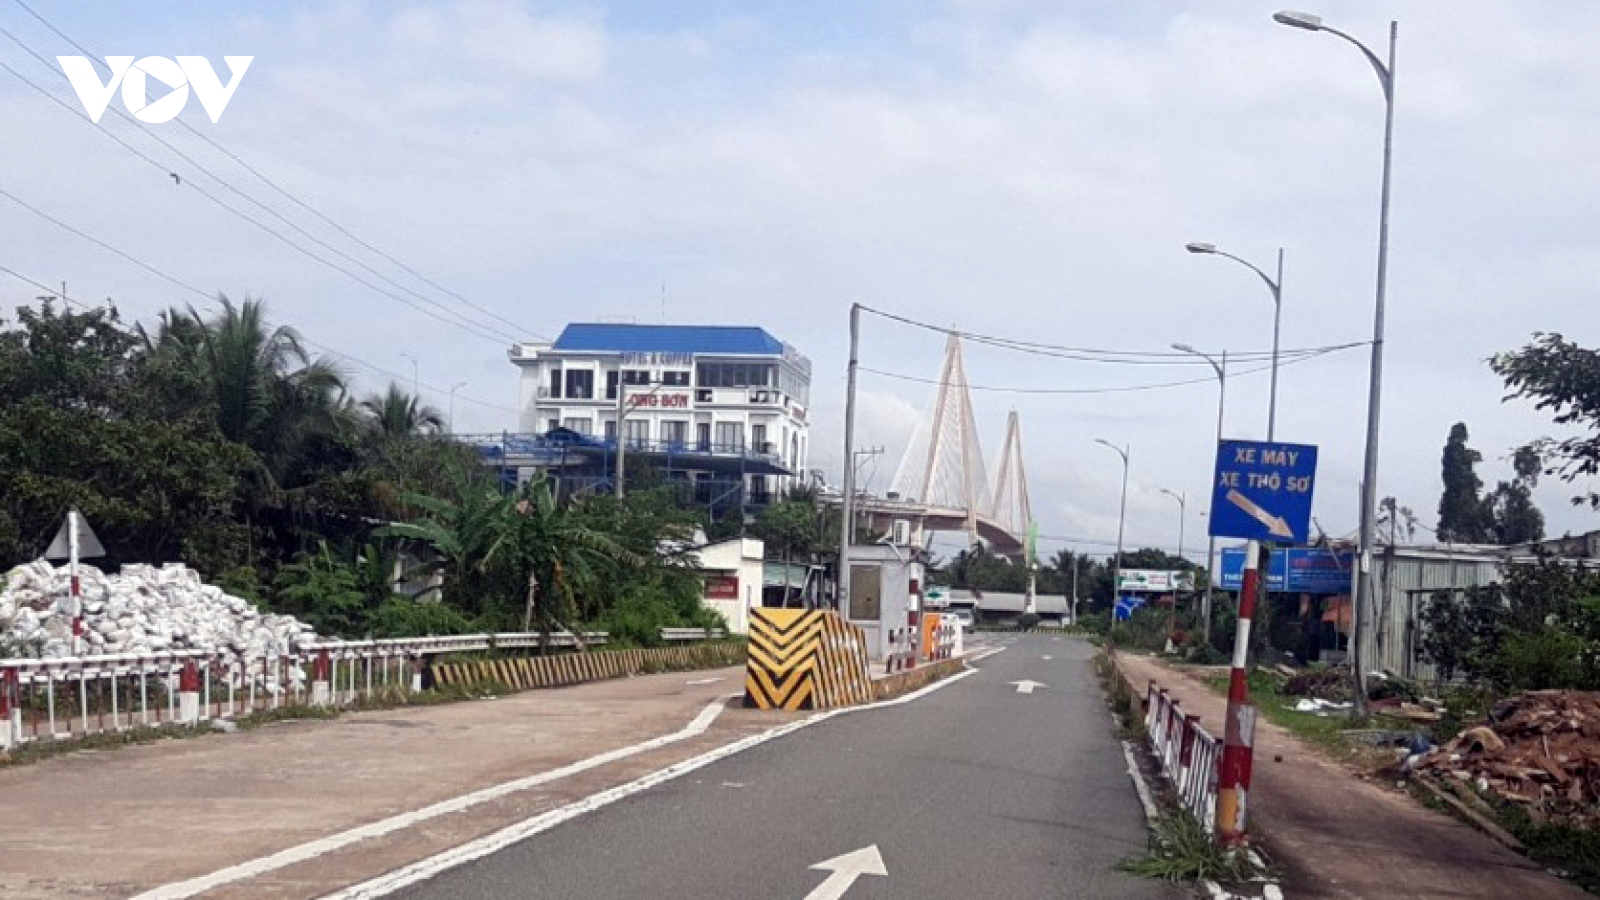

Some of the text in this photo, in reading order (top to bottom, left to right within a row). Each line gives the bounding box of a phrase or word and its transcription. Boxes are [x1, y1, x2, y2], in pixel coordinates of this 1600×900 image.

[1234, 446, 1299, 466] XE MÁY
[1220, 470, 1311, 492] XE THÔ SƠ
